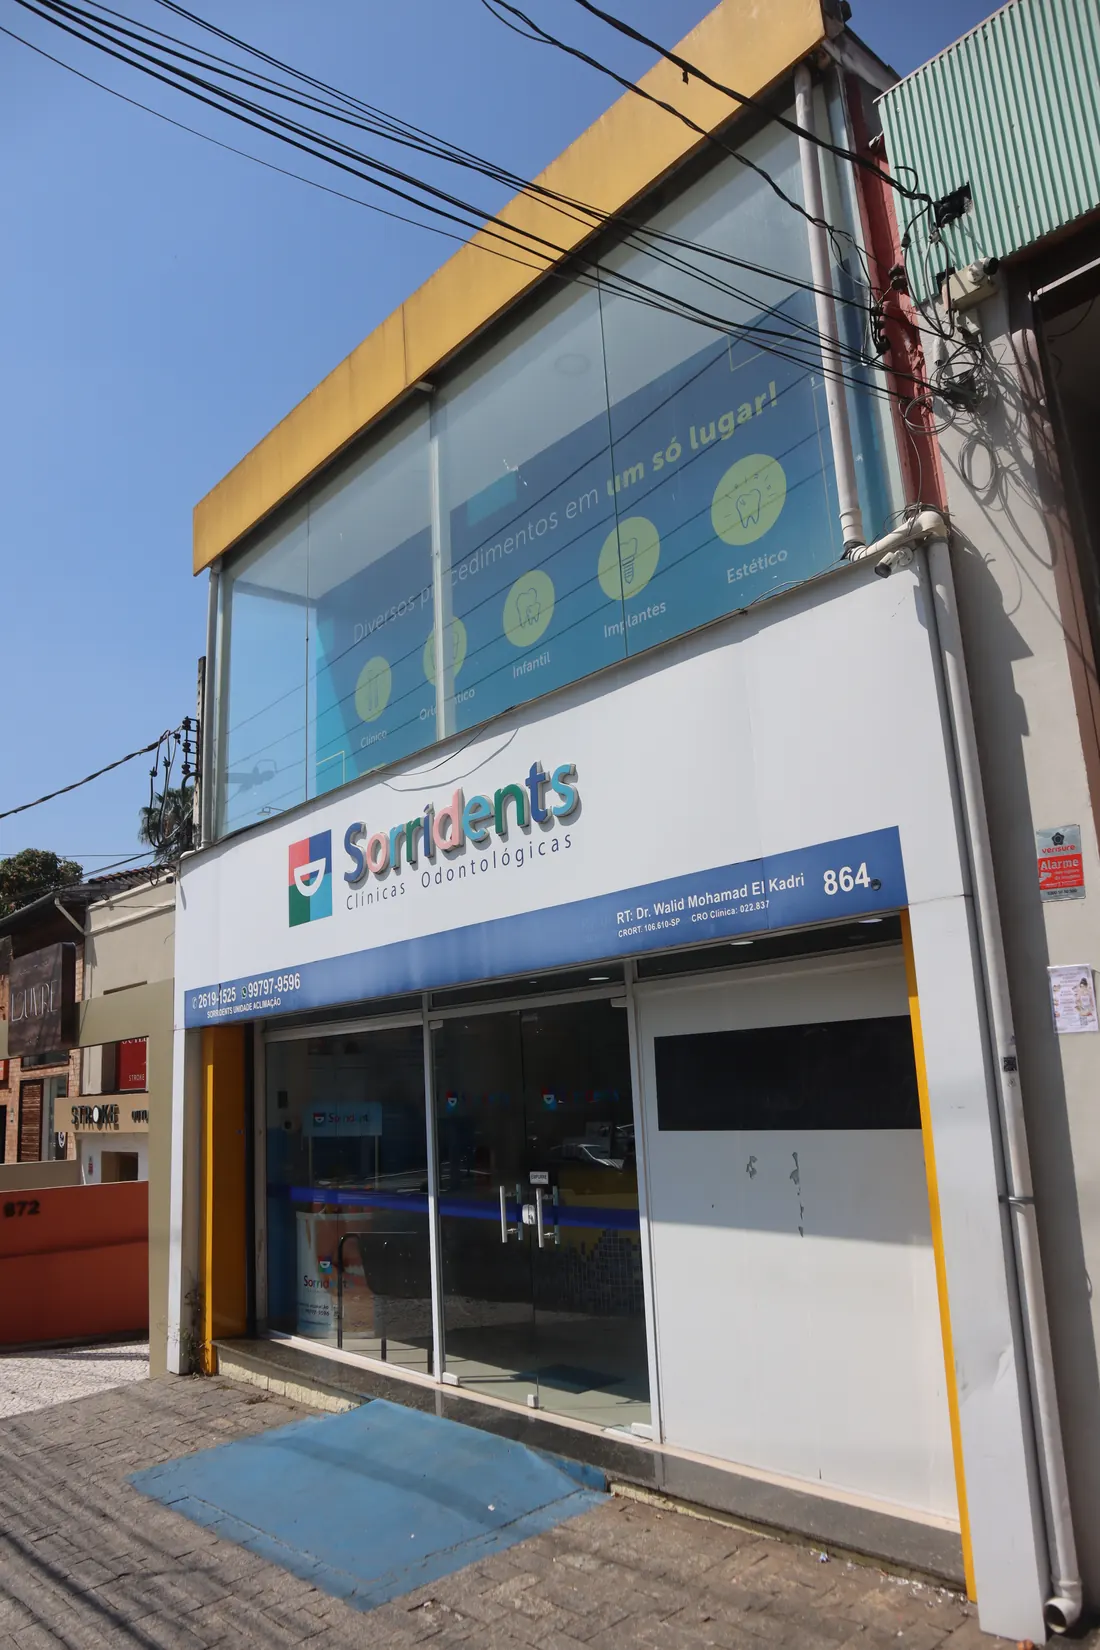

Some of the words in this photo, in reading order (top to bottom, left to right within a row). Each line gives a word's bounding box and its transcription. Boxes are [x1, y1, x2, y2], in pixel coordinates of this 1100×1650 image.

[353, 595, 416, 643] Diversos
[420, 511, 559, 611] prcedimentos
[565, 489, 599, 519] em
[606, 461, 645, 496] um
[652, 436, 682, 471] só
[689, 380, 778, 450] lugar!
[726, 550, 788, 584] Estético
[604, 601, 666, 638] Implantes
[512, 651, 551, 679] Infantil
[343, 760, 579, 884] Sorridents
[1040, 858, 1079, 871] Alarme
[1041, 844, 1076, 854] verisure
[346, 880, 406, 911] Clínicas
[421, 834, 572, 888] Odontológicas
[823, 862, 871, 896] 864
[616, 910, 633, 925] RT:
[636, 906, 651, 920] Dr.
[654, 899, 685, 917] Walid
[688, 884, 748, 909] Mohamad
[752, 881, 765, 896] El
[769, 872, 805, 893] Kadri
[691, 911, 709, 923] CRO
[740, 899, 770, 913] 022.837
[198, 987, 236, 1009] 2619-1525
[248, 972, 301, 998] 99797-9596
[207, 1006, 233, 1019] SORRIDENTS
[233, 1002, 252, 1014] UNIDADE
[253, 996, 281, 1010] ACLIMAÇÃO
[128, 1074, 145, 1082] STROKE
[71, 1103, 119, 1126] STROKE
